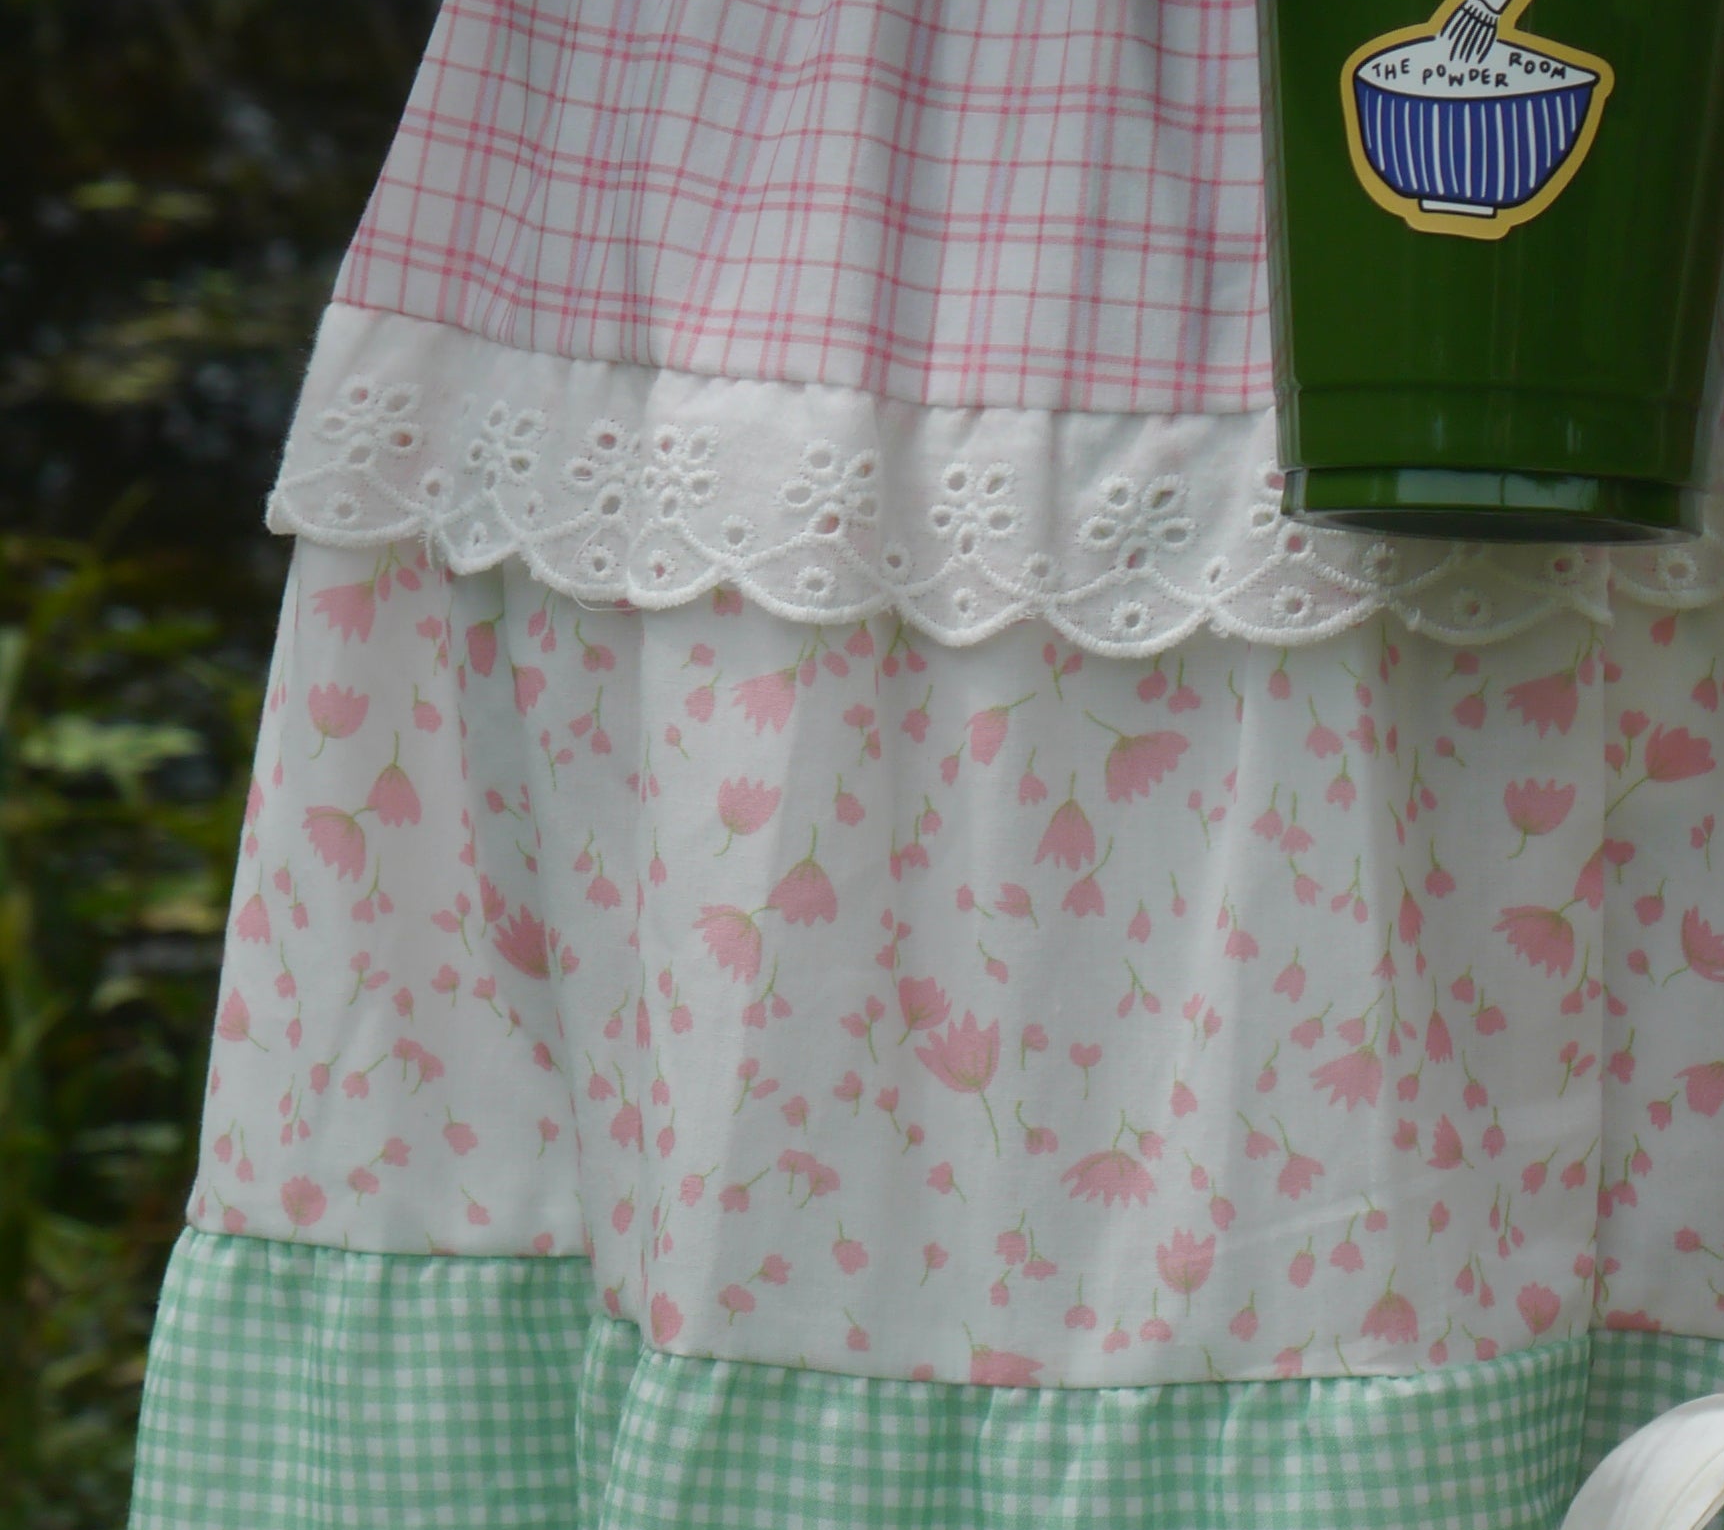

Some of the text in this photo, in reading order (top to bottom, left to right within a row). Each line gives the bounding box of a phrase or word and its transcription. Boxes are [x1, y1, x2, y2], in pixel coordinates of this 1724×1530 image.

[1371, 52, 1566, 87] THE POWDER ROOM
